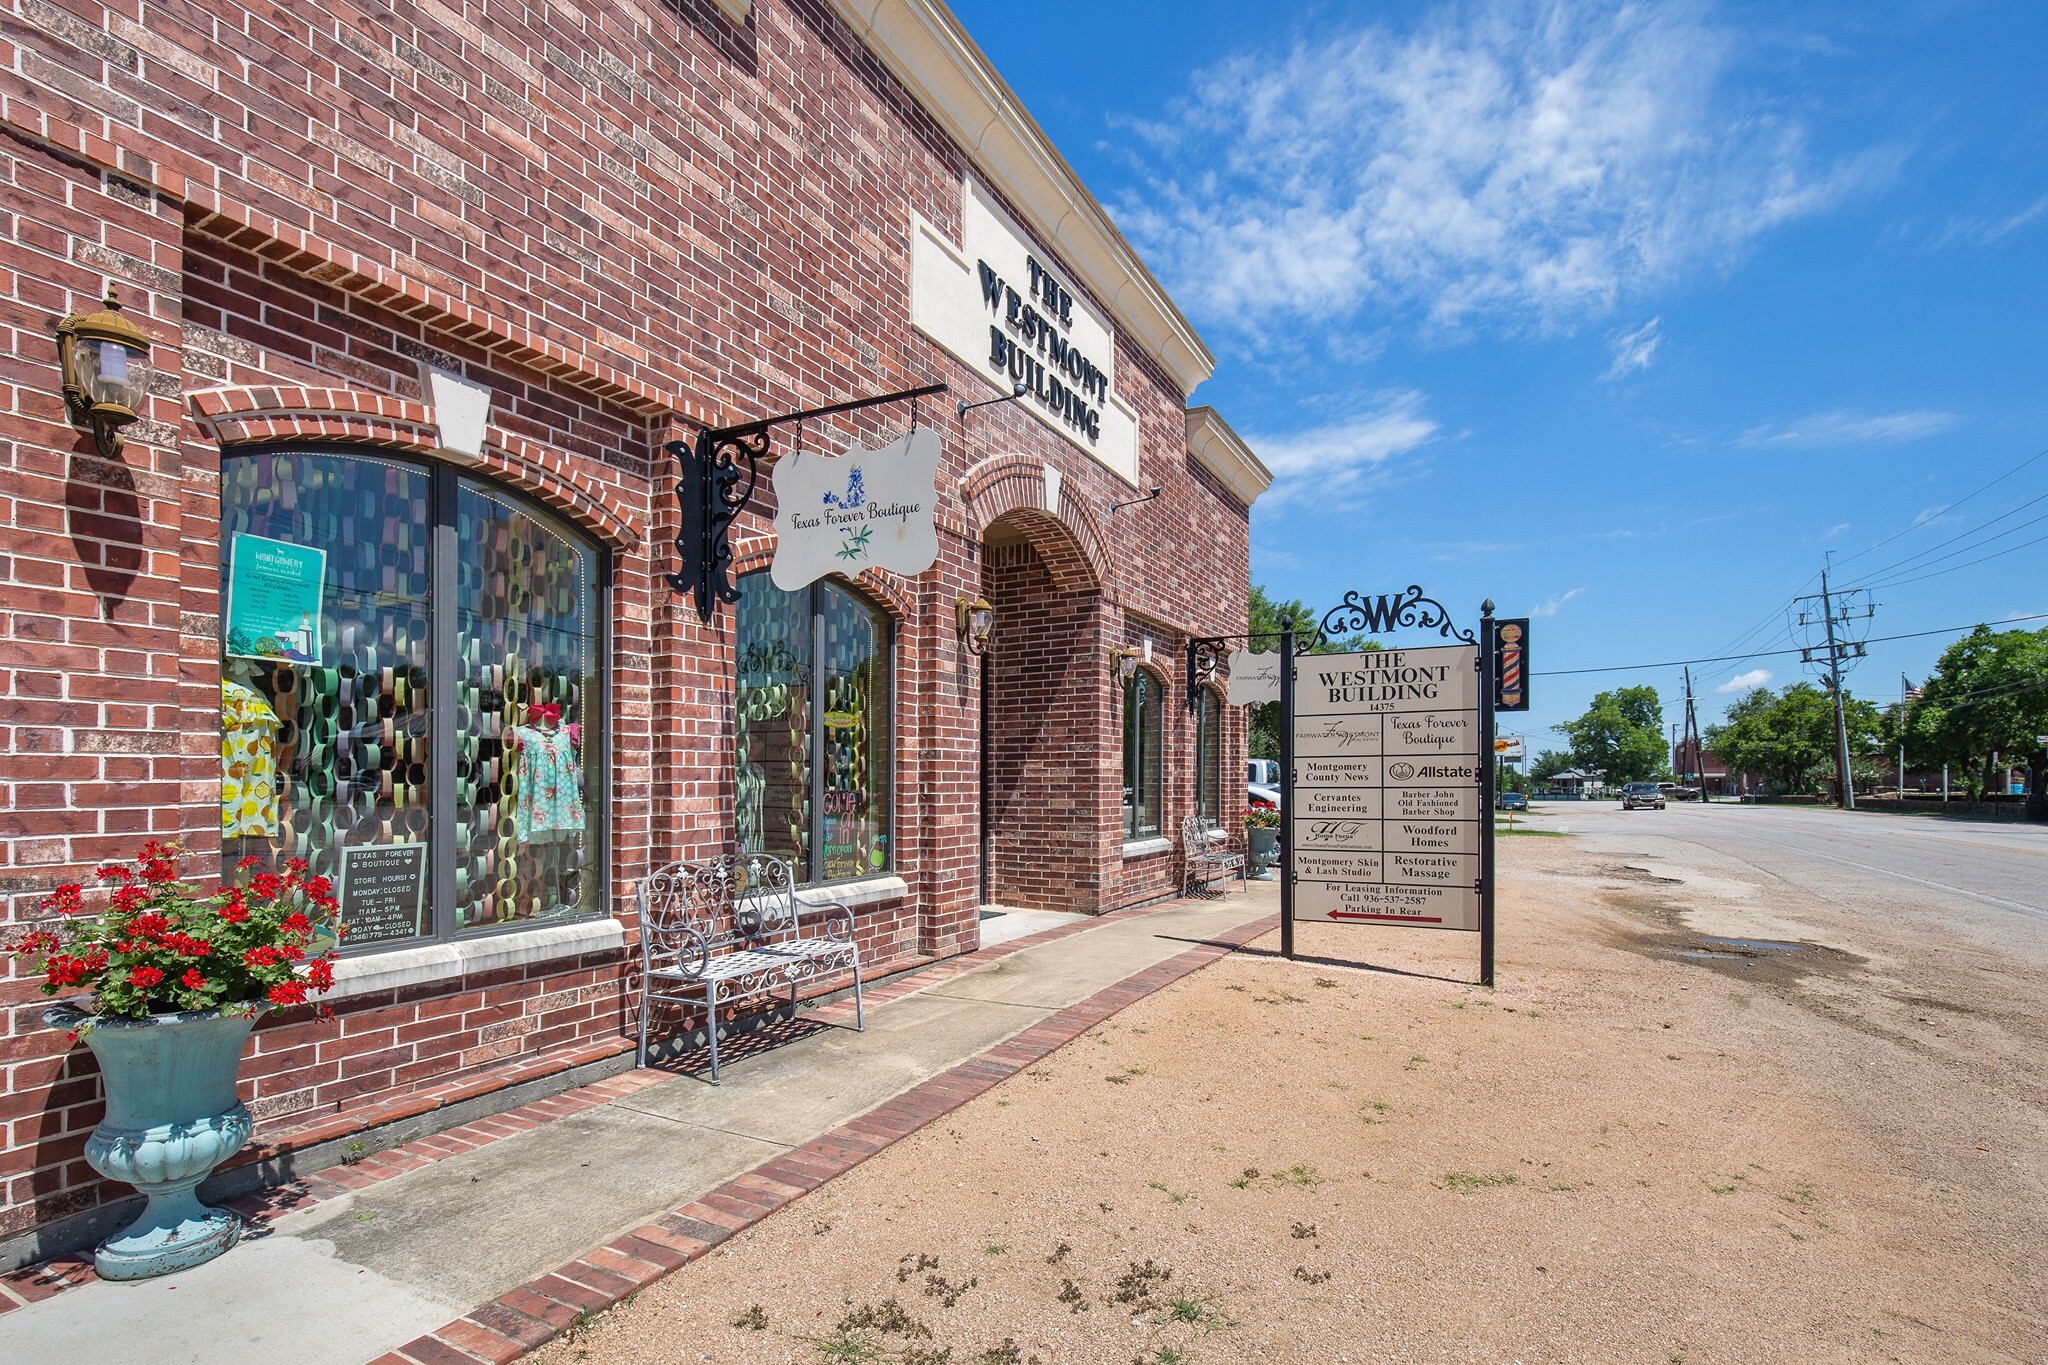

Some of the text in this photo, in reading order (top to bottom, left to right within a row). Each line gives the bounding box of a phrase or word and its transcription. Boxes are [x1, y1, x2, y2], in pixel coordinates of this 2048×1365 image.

[1026, 254, 1073, 327] THE
[977, 258, 1108, 404] WESTMONT
[989, 324, 1100, 440] BUILDING
[791, 501, 921, 530] Texas Forever Boutique
[255, 551, 304, 569] MONTGOMERY
[1360, 592, 1406, 634] W
[1360, 652, 1406, 669] THE
[1317, 665, 1450, 687] WESTMONT
[1328, 683, 1439, 703] BUILDING
[1369, 702, 1395, 711] 14375
[1390, 714, 1468, 729] Texas Forever
[1402, 730, 1456, 750] Boutique
[1307, 762, 1368, 772] Montgomery
[1417, 766, 1472, 778] Allstate
[1305, 772, 1369, 783] County News
[1313, 793, 1362, 802] Cervantes
[1402, 790, 1454, 798] Barber John
[1308, 803, 1368, 814] Engineering
[1398, 799, 1459, 807] Old Fashioned
[1402, 808, 1455, 816] Barber Shop
[1402, 825, 1458, 836] Woodford
[1411, 836, 1449, 847] Homes
[353, 849, 415, 860] TEXAS FOREVER
[362, 859, 400, 868] BOUTIQUE
[1297, 856, 1379, 867] Montgomery Skin
[1394, 855, 1458, 867] Restorative
[1304, 866, 1372, 877] & Lash Studio
[1401, 867, 1450, 880] Massage
[353, 876, 377, 885] STORE
[1326, 883, 1443, 896] For Leasing Information
[362, 898, 375, 906] TUE
[384, 896, 396, 904] FRI
[1340, 893, 1427, 906] Call 936-537-2587
[1345, 904, 1422, 916] Parking In Rear
[384, 920, 412, 930] CLOSED
